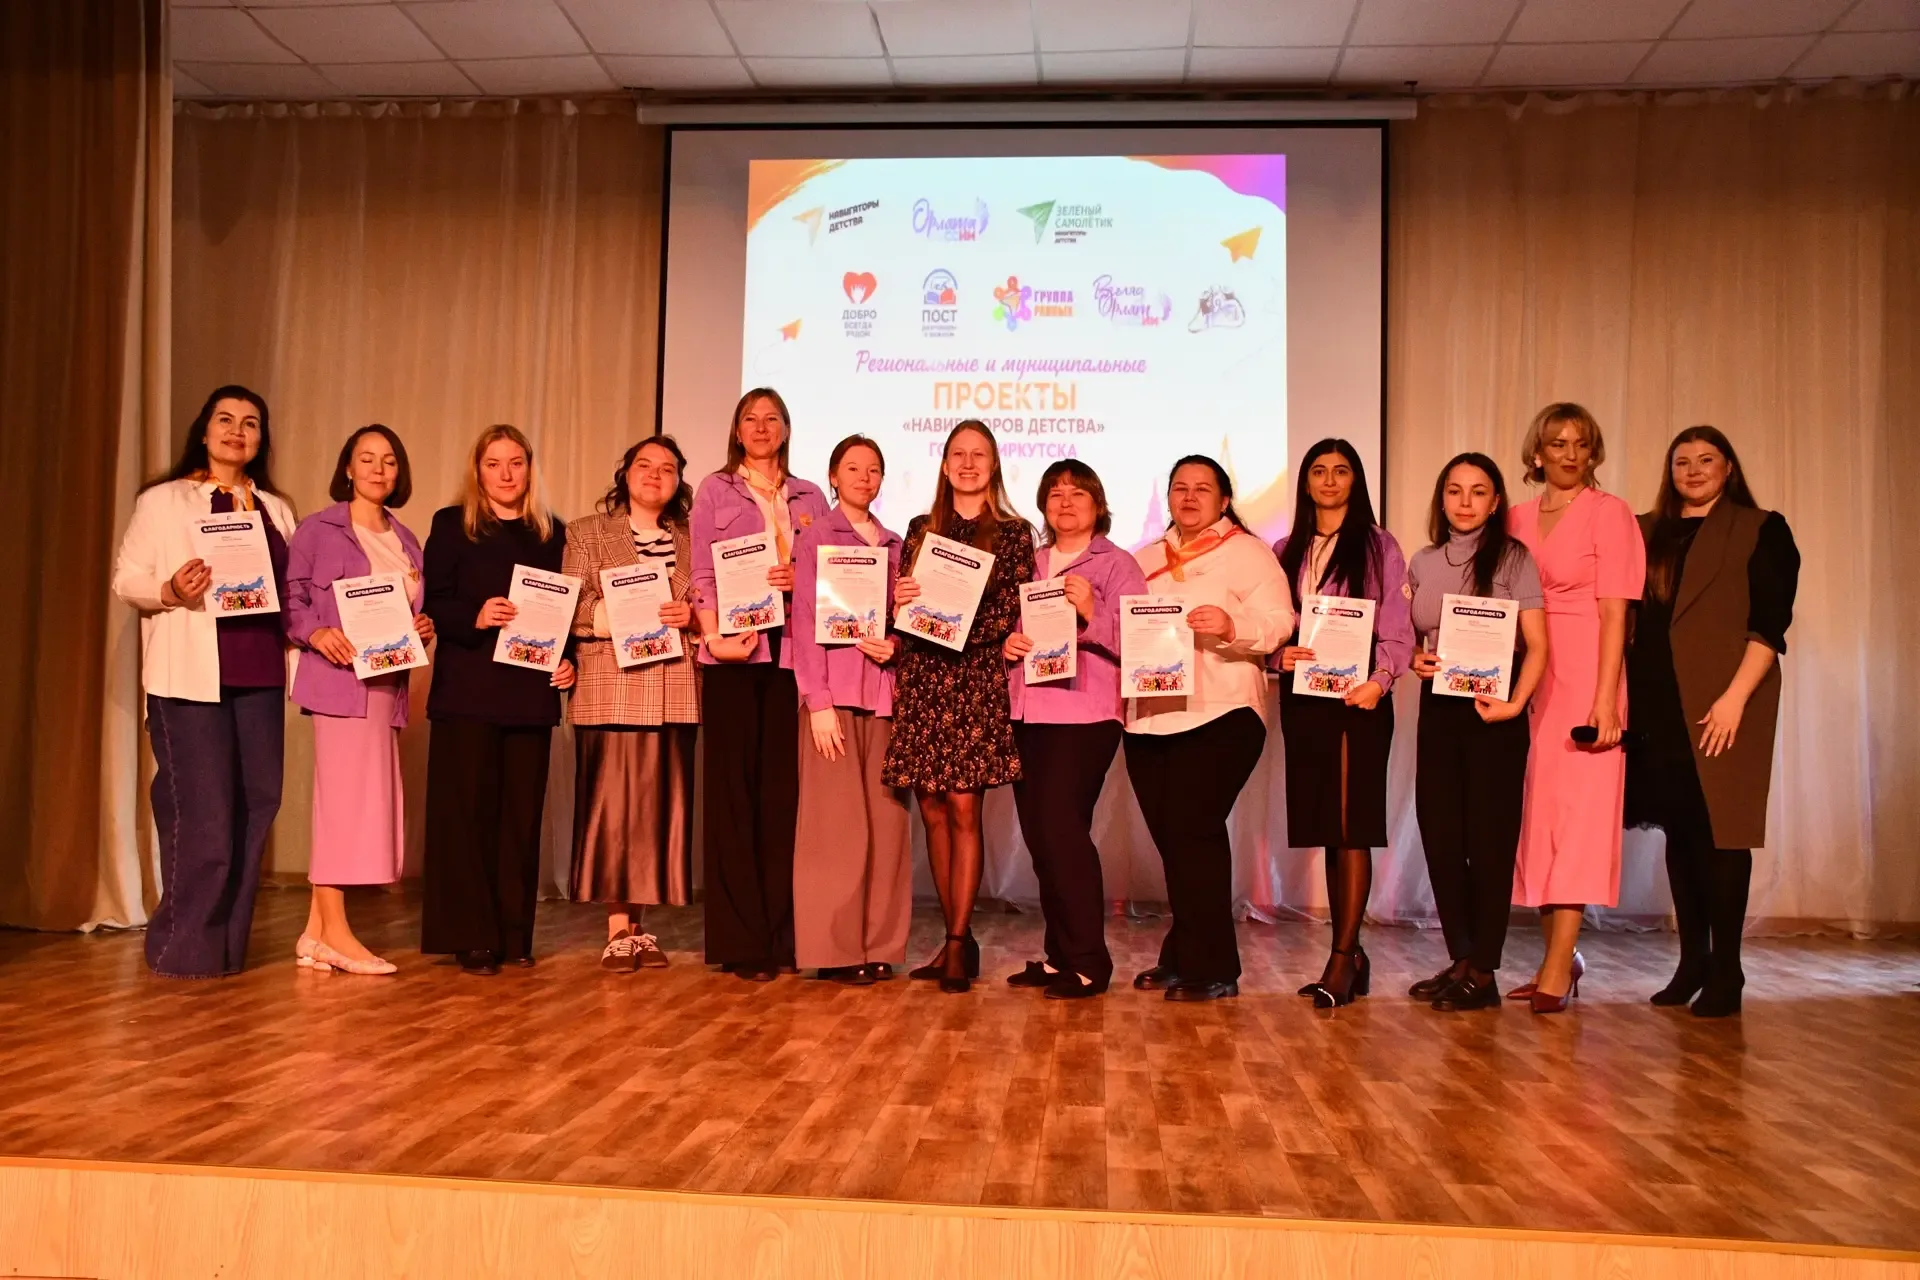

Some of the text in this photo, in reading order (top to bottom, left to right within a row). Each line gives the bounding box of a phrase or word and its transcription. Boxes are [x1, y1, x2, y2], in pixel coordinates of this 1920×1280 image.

[829, 199, 880, 220] НАВИГАТОРЫ
[829, 216, 864, 233] ДЕТСТВА
[1034, 290, 1074, 303] ГРУППА
[842, 309, 878, 320] ДОБРО
[922, 309, 958, 323] ПОСТ
[855, 350, 1147, 380] Региональные и муниципальные
[933, 381, 1077, 411] ПРОЕКТЫ
[1027, 418, 1105, 434] ДЕТСТВА»
[203, 523, 251, 532] БЛАГОДАРНОСТЬ
[723, 545, 765, 559] БЛАГОДАРНОСТЬ
[934, 548, 979, 568] БЛАГОДАРНОСТЬ
[524, 578, 567, 593] БЛАГОДАРНОСТЬ
[613, 574, 656, 587] БЛАГОДАРНОСТЬ
[348, 585, 392, 597] БЛАГОДАРНОСТЬ
[1455, 608, 1503, 617] БЛАГОДАРНОСТЬ
